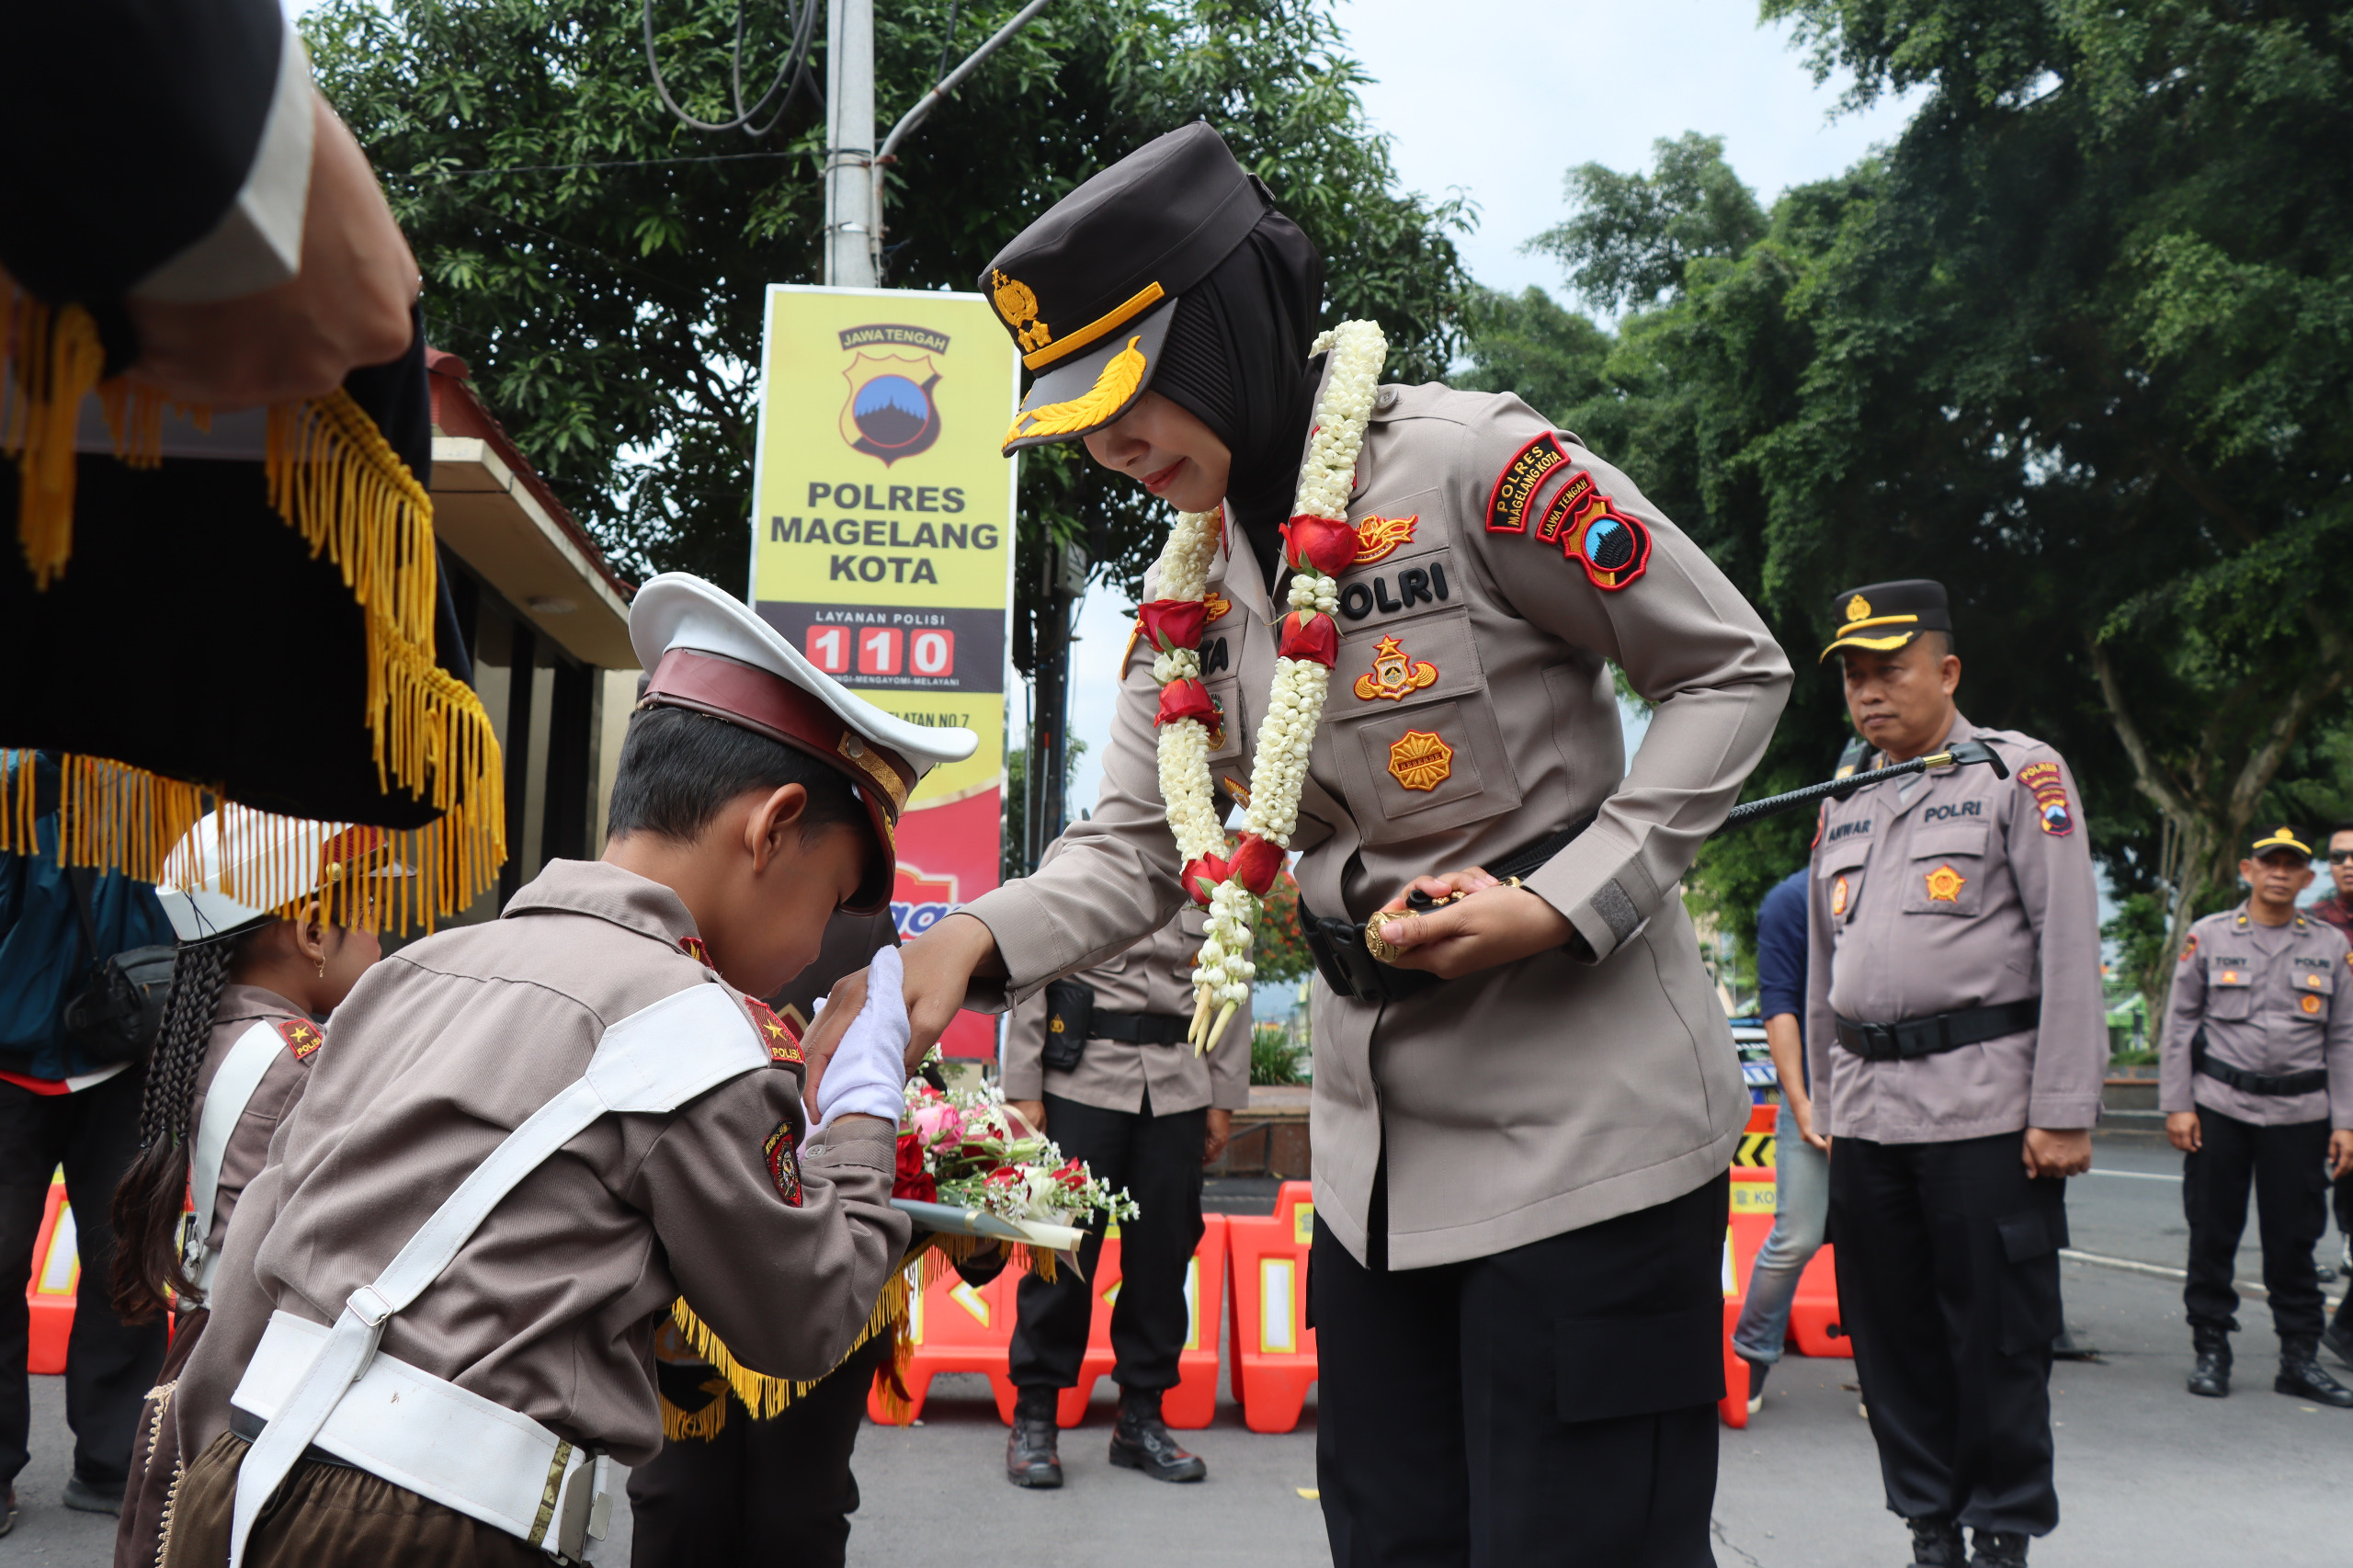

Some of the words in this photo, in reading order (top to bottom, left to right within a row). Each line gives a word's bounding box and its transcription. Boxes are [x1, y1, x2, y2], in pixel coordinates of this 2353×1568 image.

[844, 329, 884, 347] JAWA
[885, 328, 946, 351] TENGAH
[1496, 446, 1544, 513] POLRES
[1507, 470, 1540, 526] MAGELANG
[1538, 450, 1563, 473] KOTA
[808, 482, 966, 514] POLRES
[1544, 509, 1563, 536] JAWA
[1560, 479, 1588, 510] TENGAH
[770, 516, 1000, 551] MAGELANG
[829, 554, 938, 585] KOTA
[815, 610, 887, 624] LAYANAN
[892, 613, 946, 626] POLISI
[814, 629, 949, 674] 110
[2020, 763, 2058, 780] POLRES
[1925, 801, 1982, 823] POLRI
[1827, 819, 1871, 843] ANWAR
[297, 1037, 322, 1056] POLISI
